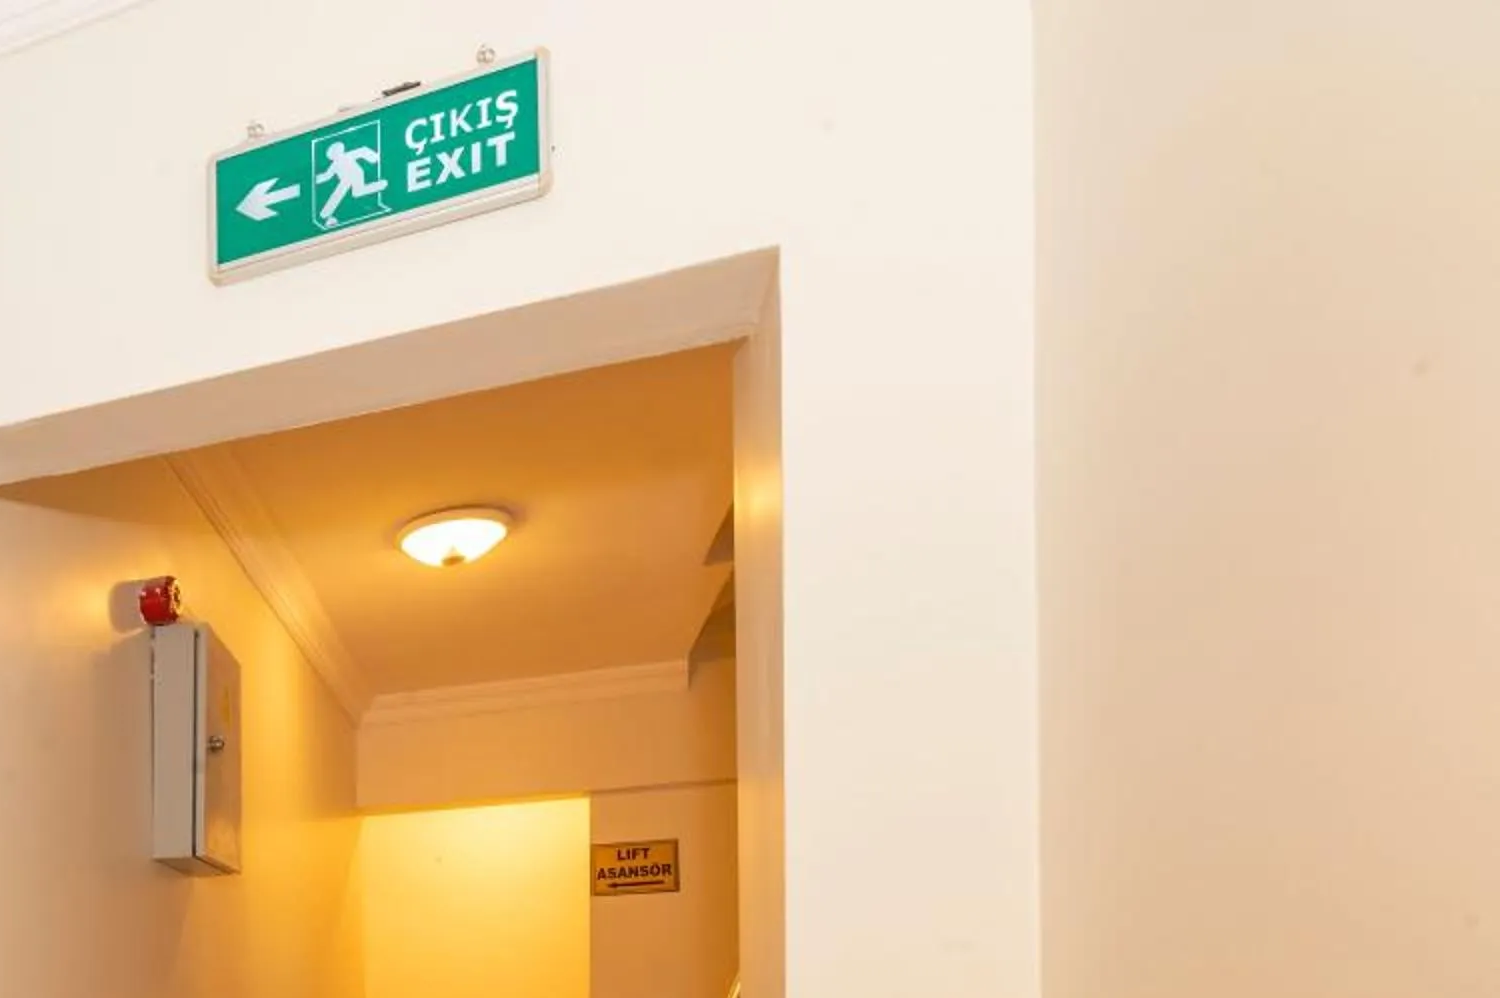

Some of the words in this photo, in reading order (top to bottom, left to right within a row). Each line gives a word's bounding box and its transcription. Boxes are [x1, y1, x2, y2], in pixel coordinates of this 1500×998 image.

[405, 90, 519, 154] ÇIKIŞ
[407, 132, 516, 192] EXIT
[616, 847, 650, 861] LIFT
